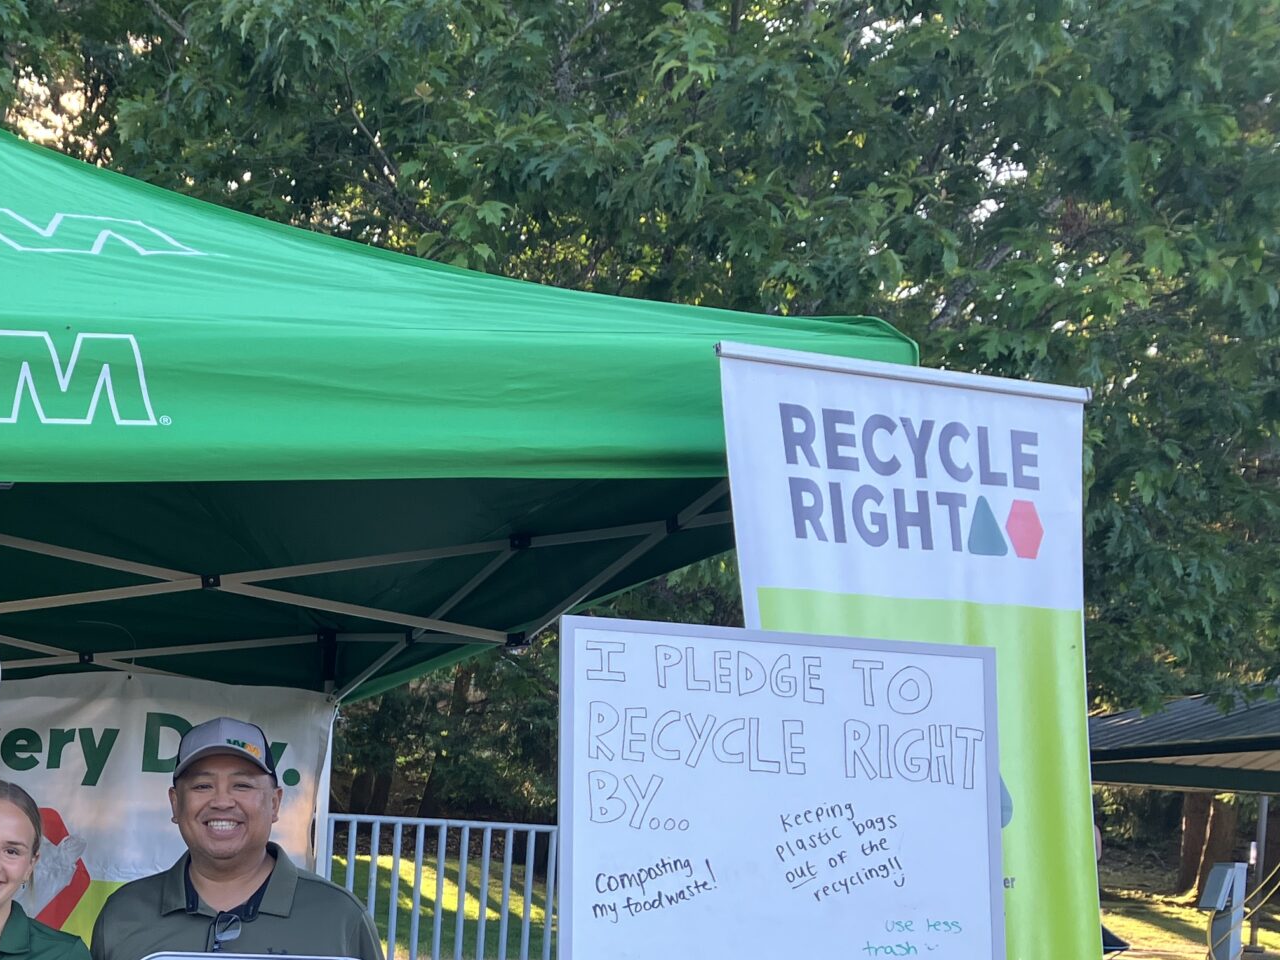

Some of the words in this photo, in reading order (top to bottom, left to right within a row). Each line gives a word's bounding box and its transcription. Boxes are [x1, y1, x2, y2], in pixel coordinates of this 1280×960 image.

[779, 402, 1040, 491] RECYCLE
[788, 476, 967, 552] RIGHT
[586, 640, 626, 682] I
[655, 644, 824, 704] PLEDGE
[853, 659, 933, 715] TO
[587, 700, 807, 775] RECYCLE
[844, 719, 984, 790] RIGHT
[588, 769, 690, 832] BY...
[852, 814, 898, 836] bags
[595, 856, 693, 896] Composting
[785, 861, 818, 883] out
[828, 850, 847, 868] of
[861, 838, 890, 856] the
[592, 901, 618, 924] my
[885, 919, 915, 933] use
[862, 940, 918, 957] trash
